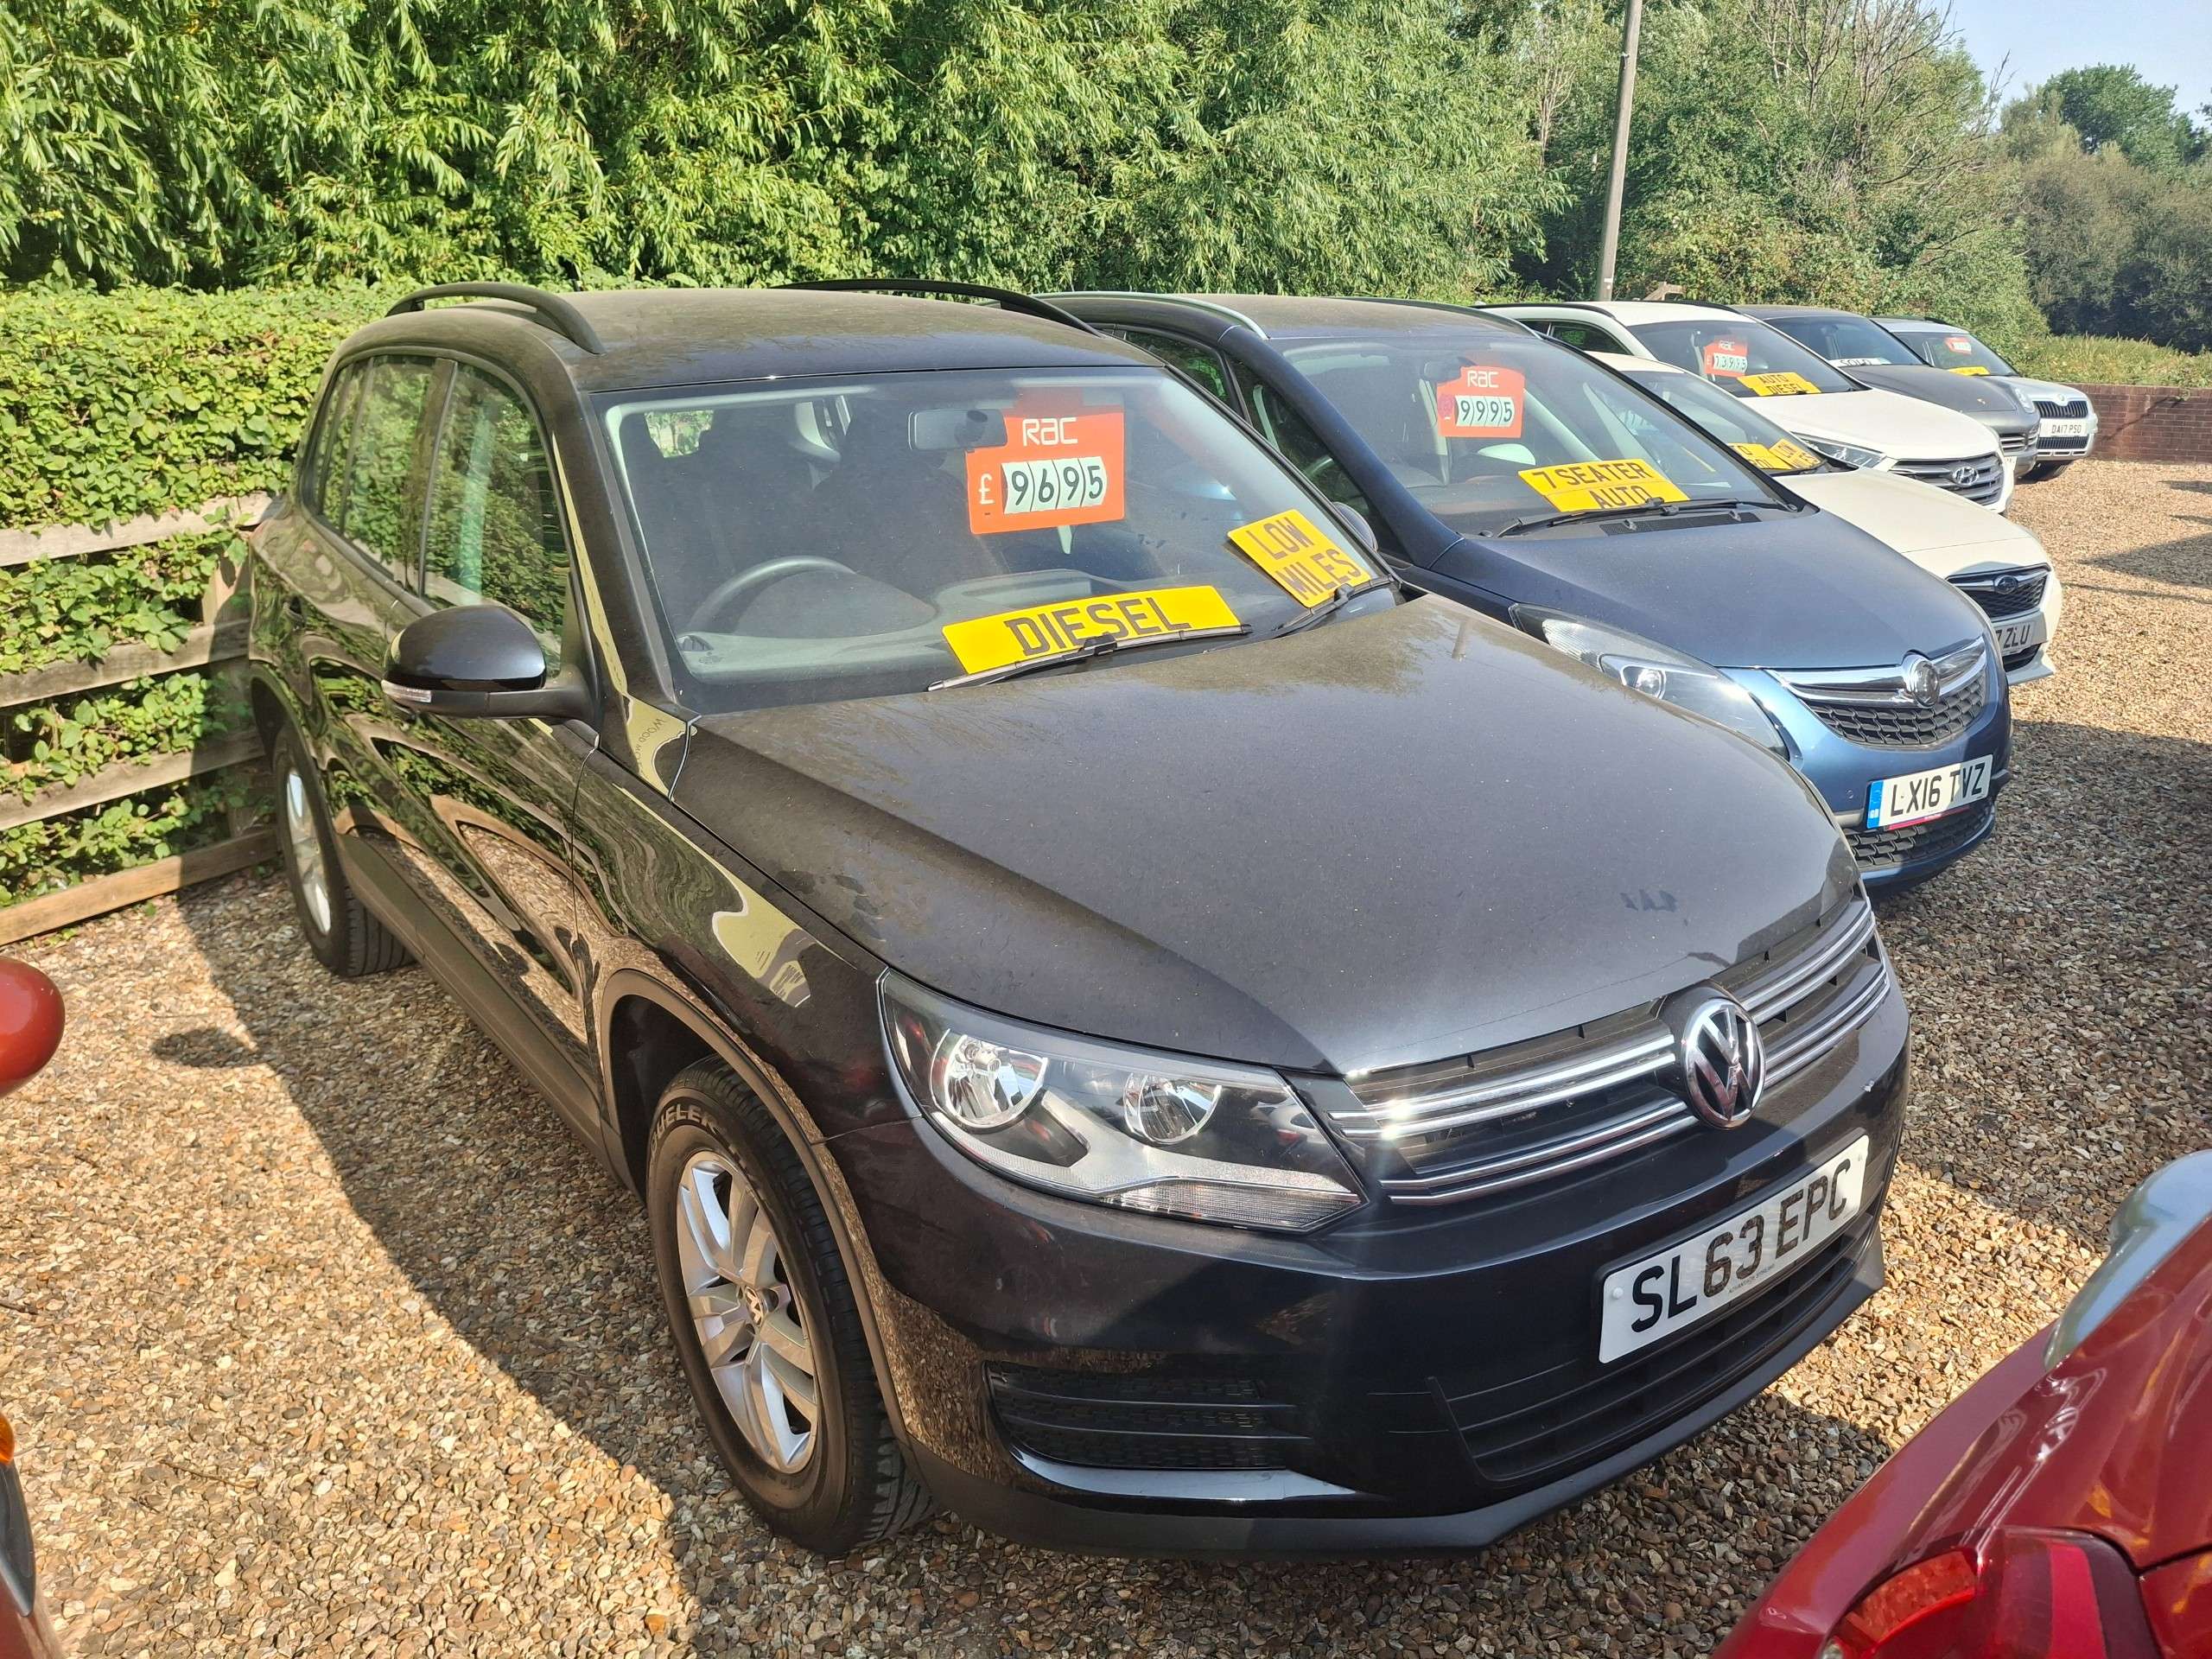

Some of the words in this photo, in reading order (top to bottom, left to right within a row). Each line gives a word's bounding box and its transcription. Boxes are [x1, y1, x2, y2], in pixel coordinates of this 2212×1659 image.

[1758, 374, 1789, 385] AUTO
[1460, 399, 1513, 423] 9995
[1011, 465, 1103, 506] 9695
[1532, 472, 1558, 490] 7
[1559, 461, 1654, 486] SEATER
[1588, 486, 1650, 510] AUTO
[1245, 516, 1316, 561] LOW
[1274, 547, 1364, 601] MILES
[1003, 596, 1193, 658] DIESEL
[2003, 624, 2031, 649] ZLU
[1890, 775, 1942, 817] LX16
[1948, 762, 1986, 803] TVZ
[1630, 1213, 1764, 1334] SL63
[1775, 1157, 1851, 1260] EPC
